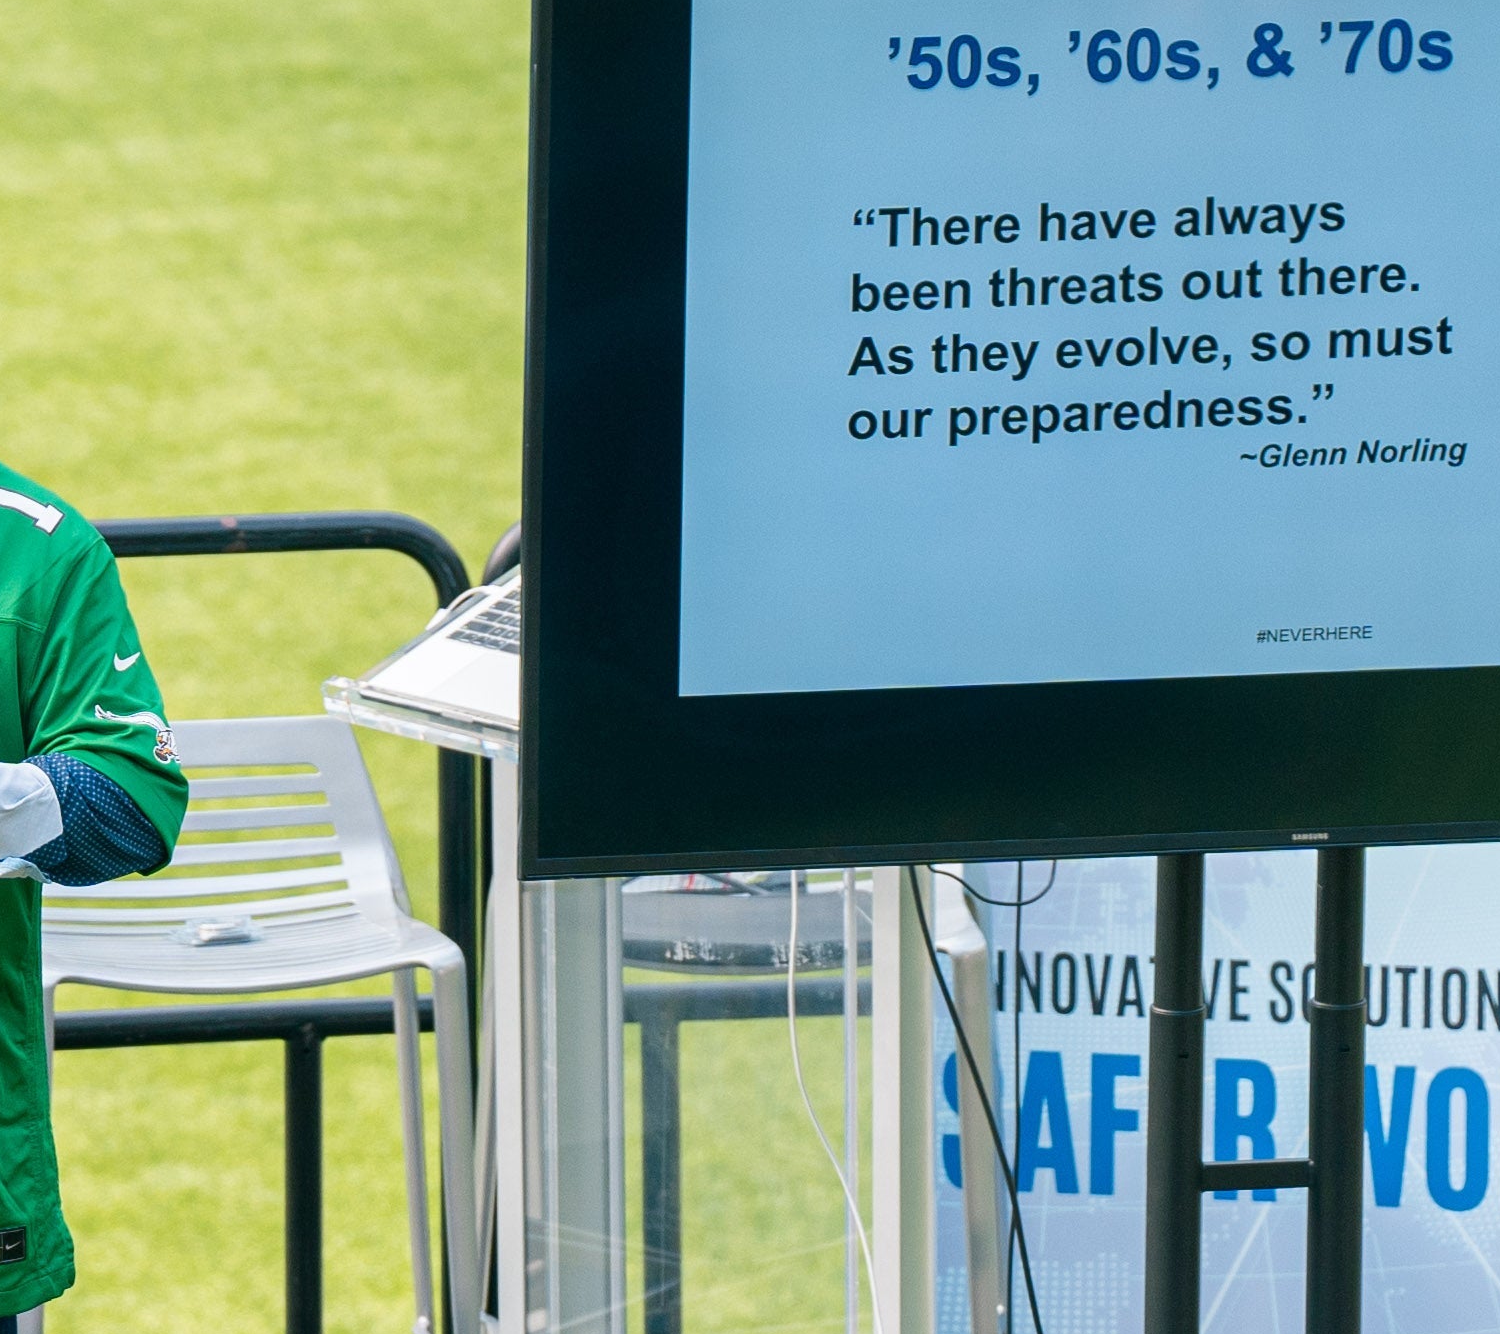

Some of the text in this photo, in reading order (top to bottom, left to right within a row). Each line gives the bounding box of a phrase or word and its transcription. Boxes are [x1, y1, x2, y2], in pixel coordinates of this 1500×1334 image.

[1247, 23, 1294, 78] &
[854, 197, 1345, 247] “There have always
[852, 257, 1419, 312] been threats out there.
[849, 317, 1452, 381] As they evolve, so must
[849, 384, 1335, 447] our preparedness.”
[1241, 438, 1467, 467] ~Glenn Norling
[1257, 626, 1372, 643] #NEVERHERE
